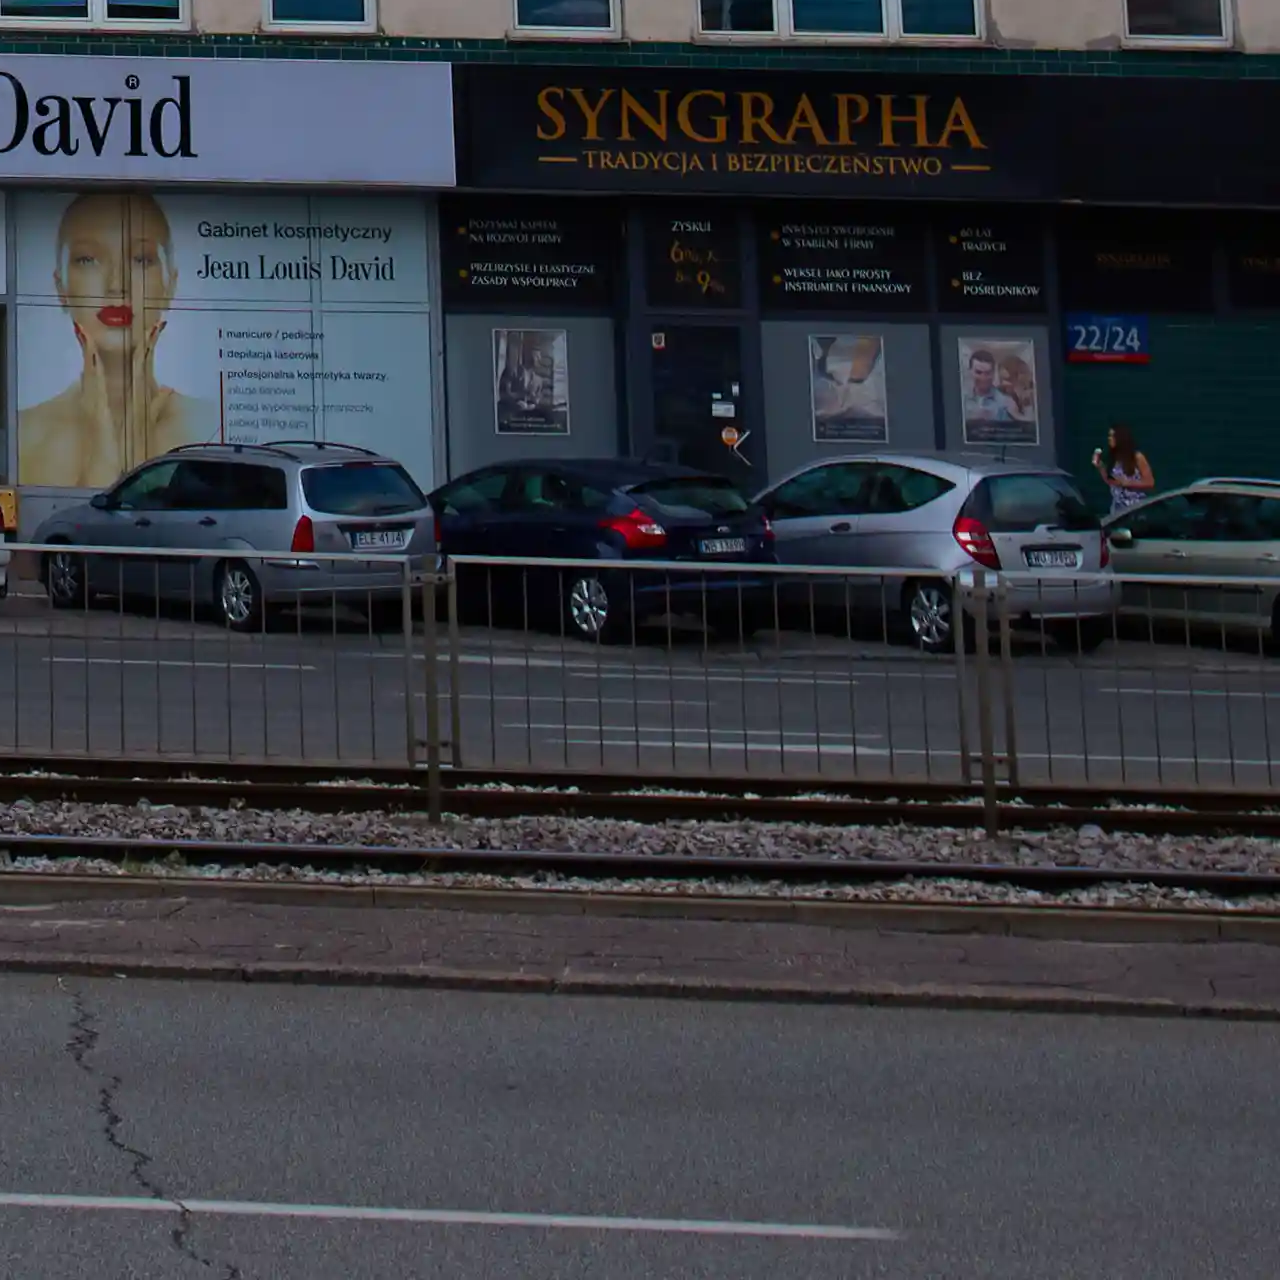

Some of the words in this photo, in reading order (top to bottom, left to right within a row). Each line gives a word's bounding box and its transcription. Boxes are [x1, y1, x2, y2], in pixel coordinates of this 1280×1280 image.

[536, 85, 989, 150] SYNGRAPHA
[582, 149, 704, 178] TRADYCJA
[709, 150, 718, 171] I
[727, 150, 942, 177] BEZPIECZEŃSTWO
[198, 221, 268, 238] Gabinet
[274, 222, 392, 244] kosmetyczny
[469, 233, 484, 243] NA
[531, 234, 562, 244] FIRMY
[795, 238, 839, 249] STABILNE
[843, 239, 875, 250] FIRMY
[197, 254, 250, 279] Jean
[258, 254, 322, 280] Louis
[330, 255, 395, 281] David
[540, 263, 596, 274] ELASTYCZNE
[784, 268, 823, 278] WEKSEL
[826, 268, 850, 279] JAKO
[852, 269, 893, 280] PROSTY
[962, 271, 983, 281] BEZ
[471, 276, 509, 286] ZASADY
[785, 281, 849, 292] INSTRUMENT
[852, 282, 912, 294] FINANSOWY
[963, 283, 1041, 297] POŚREDNIKÓW
[227, 330, 272, 339] manicure
[282, 330, 325, 340] pedicure
[1073, 324, 1141, 353] 22/24
[227, 349, 272, 360] depilacja
[274, 350, 319, 360] laserowa
[227, 370, 295, 380] profesjonalna
[297, 370, 351, 381] kosmetyka
